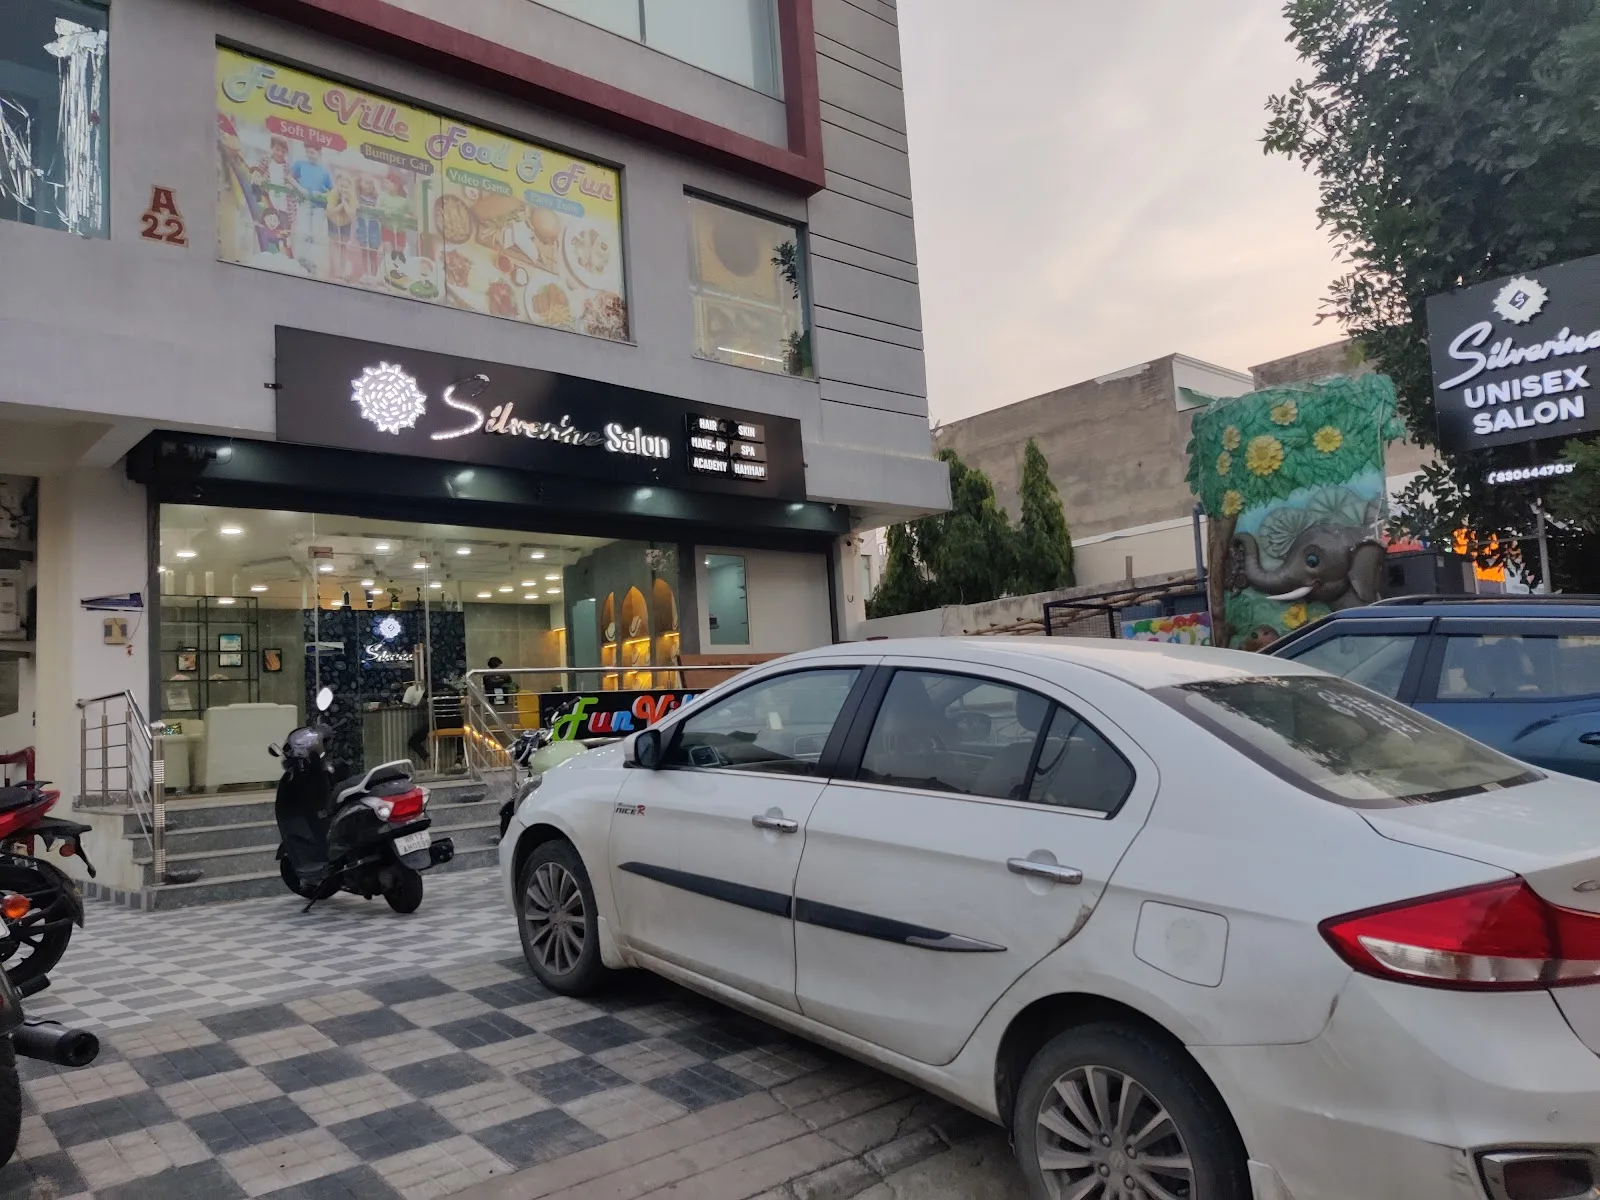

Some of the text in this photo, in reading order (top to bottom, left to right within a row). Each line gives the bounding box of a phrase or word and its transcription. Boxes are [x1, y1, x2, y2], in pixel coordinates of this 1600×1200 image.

[222, 65, 312, 114] Fun
[323, 88, 410, 142] Ville
[425, 126, 509, 171] Food
[551, 163, 614, 202] Fun
[280, 121, 332, 147] Soft Play
[365, 146, 429, 172] Bumper Car
[450, 170, 510, 196] Video Game
[151, 186, 179, 216] A
[141, 213, 186, 245] 22
[1464, 365, 1591, 409] UNISEX
[699, 418, 717, 431] HAIR
[1472, 395, 1585, 435] SALON
[604, 422, 670, 459] Salon
[738, 424, 755, 437] SKIN
[693, 457, 727, 472] ACADEMY
[741, 445, 755, 457] SPA
[553, 697, 634, 741] Fun
